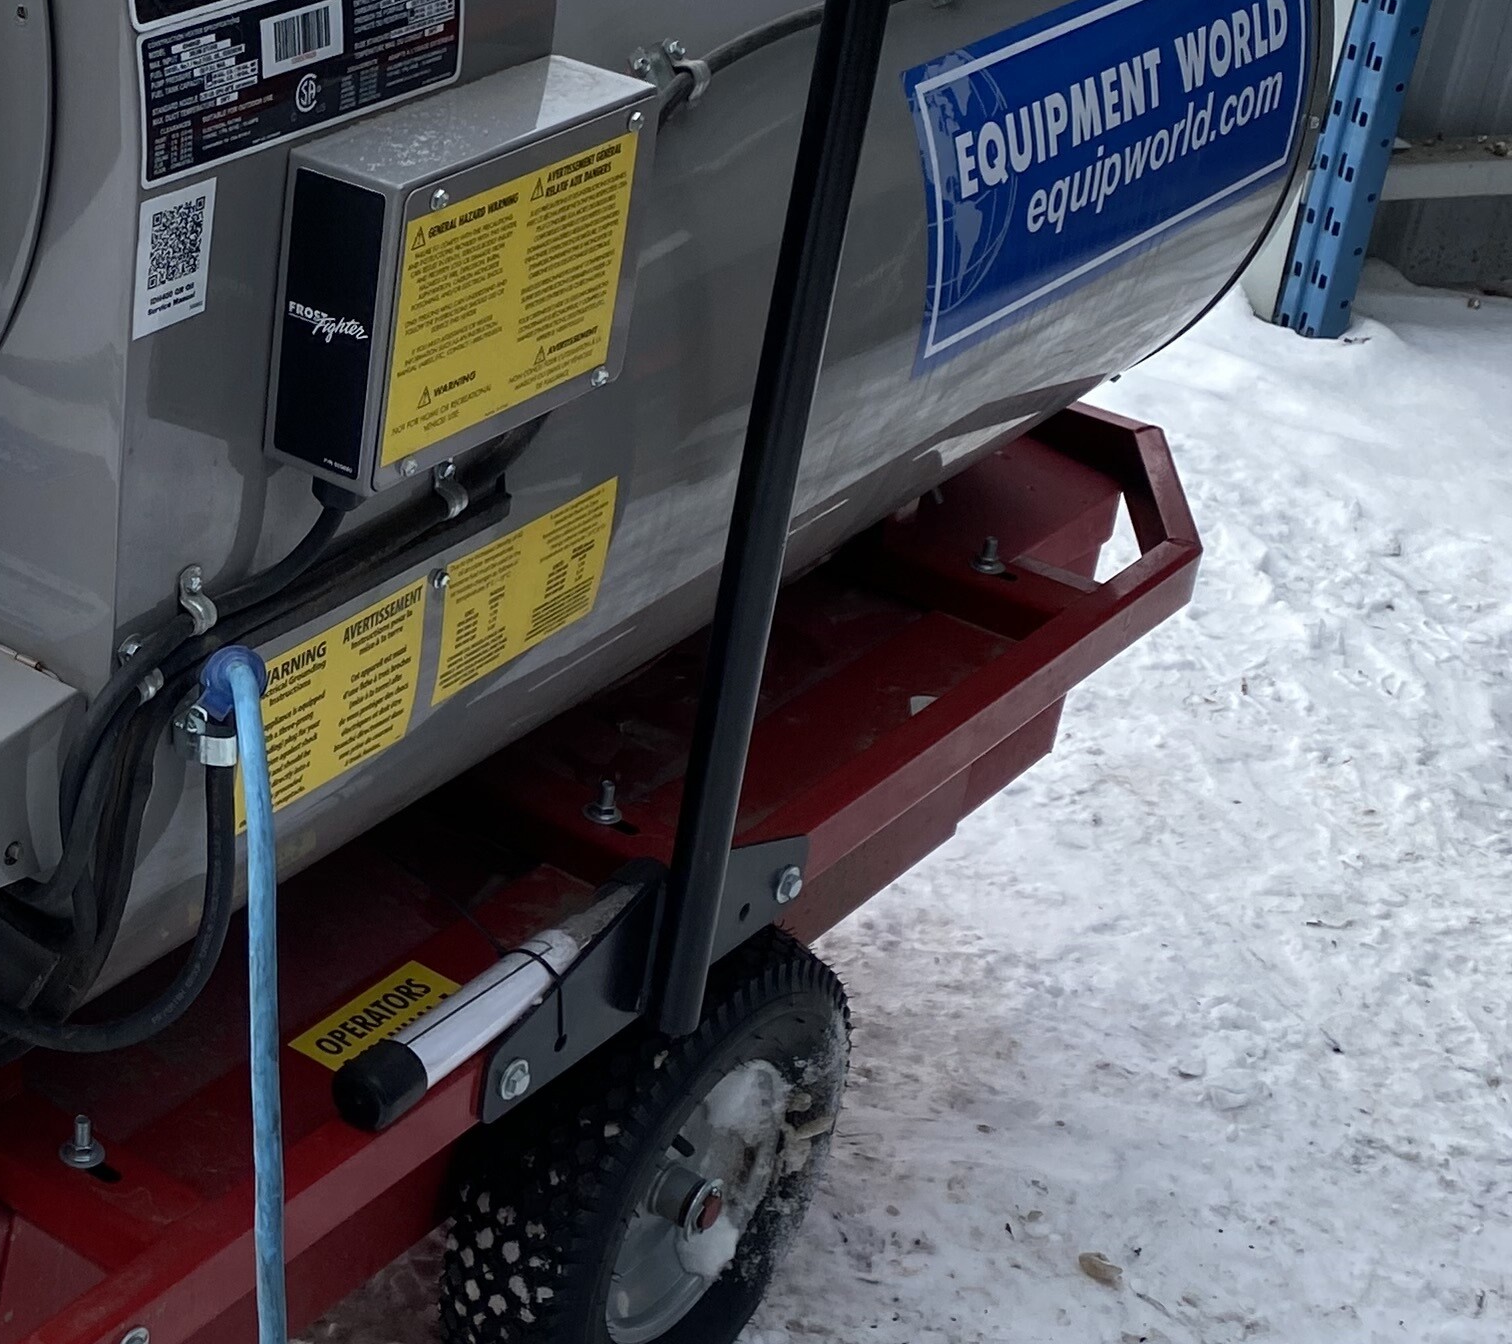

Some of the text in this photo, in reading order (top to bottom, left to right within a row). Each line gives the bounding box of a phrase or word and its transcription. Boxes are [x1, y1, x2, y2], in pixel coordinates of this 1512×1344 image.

[955, 47, 1162, 199] EQUIPMENT
[1026, 70, 1284, 234] equipworld.com
[428, 192, 518, 238] GENERAL HAZARD WARNING
[148, 291, 195, 316] Service Manual
[289, 300, 368, 343] FROST Fighter
[434, 370, 475, 397] WARNING
[343, 585, 422, 643] AVERTISSEMENT
[270, 678, 310, 706] Instructions
[289, 659, 325, 685] Grounding
[315, 978, 432, 1055] OPERATORS
